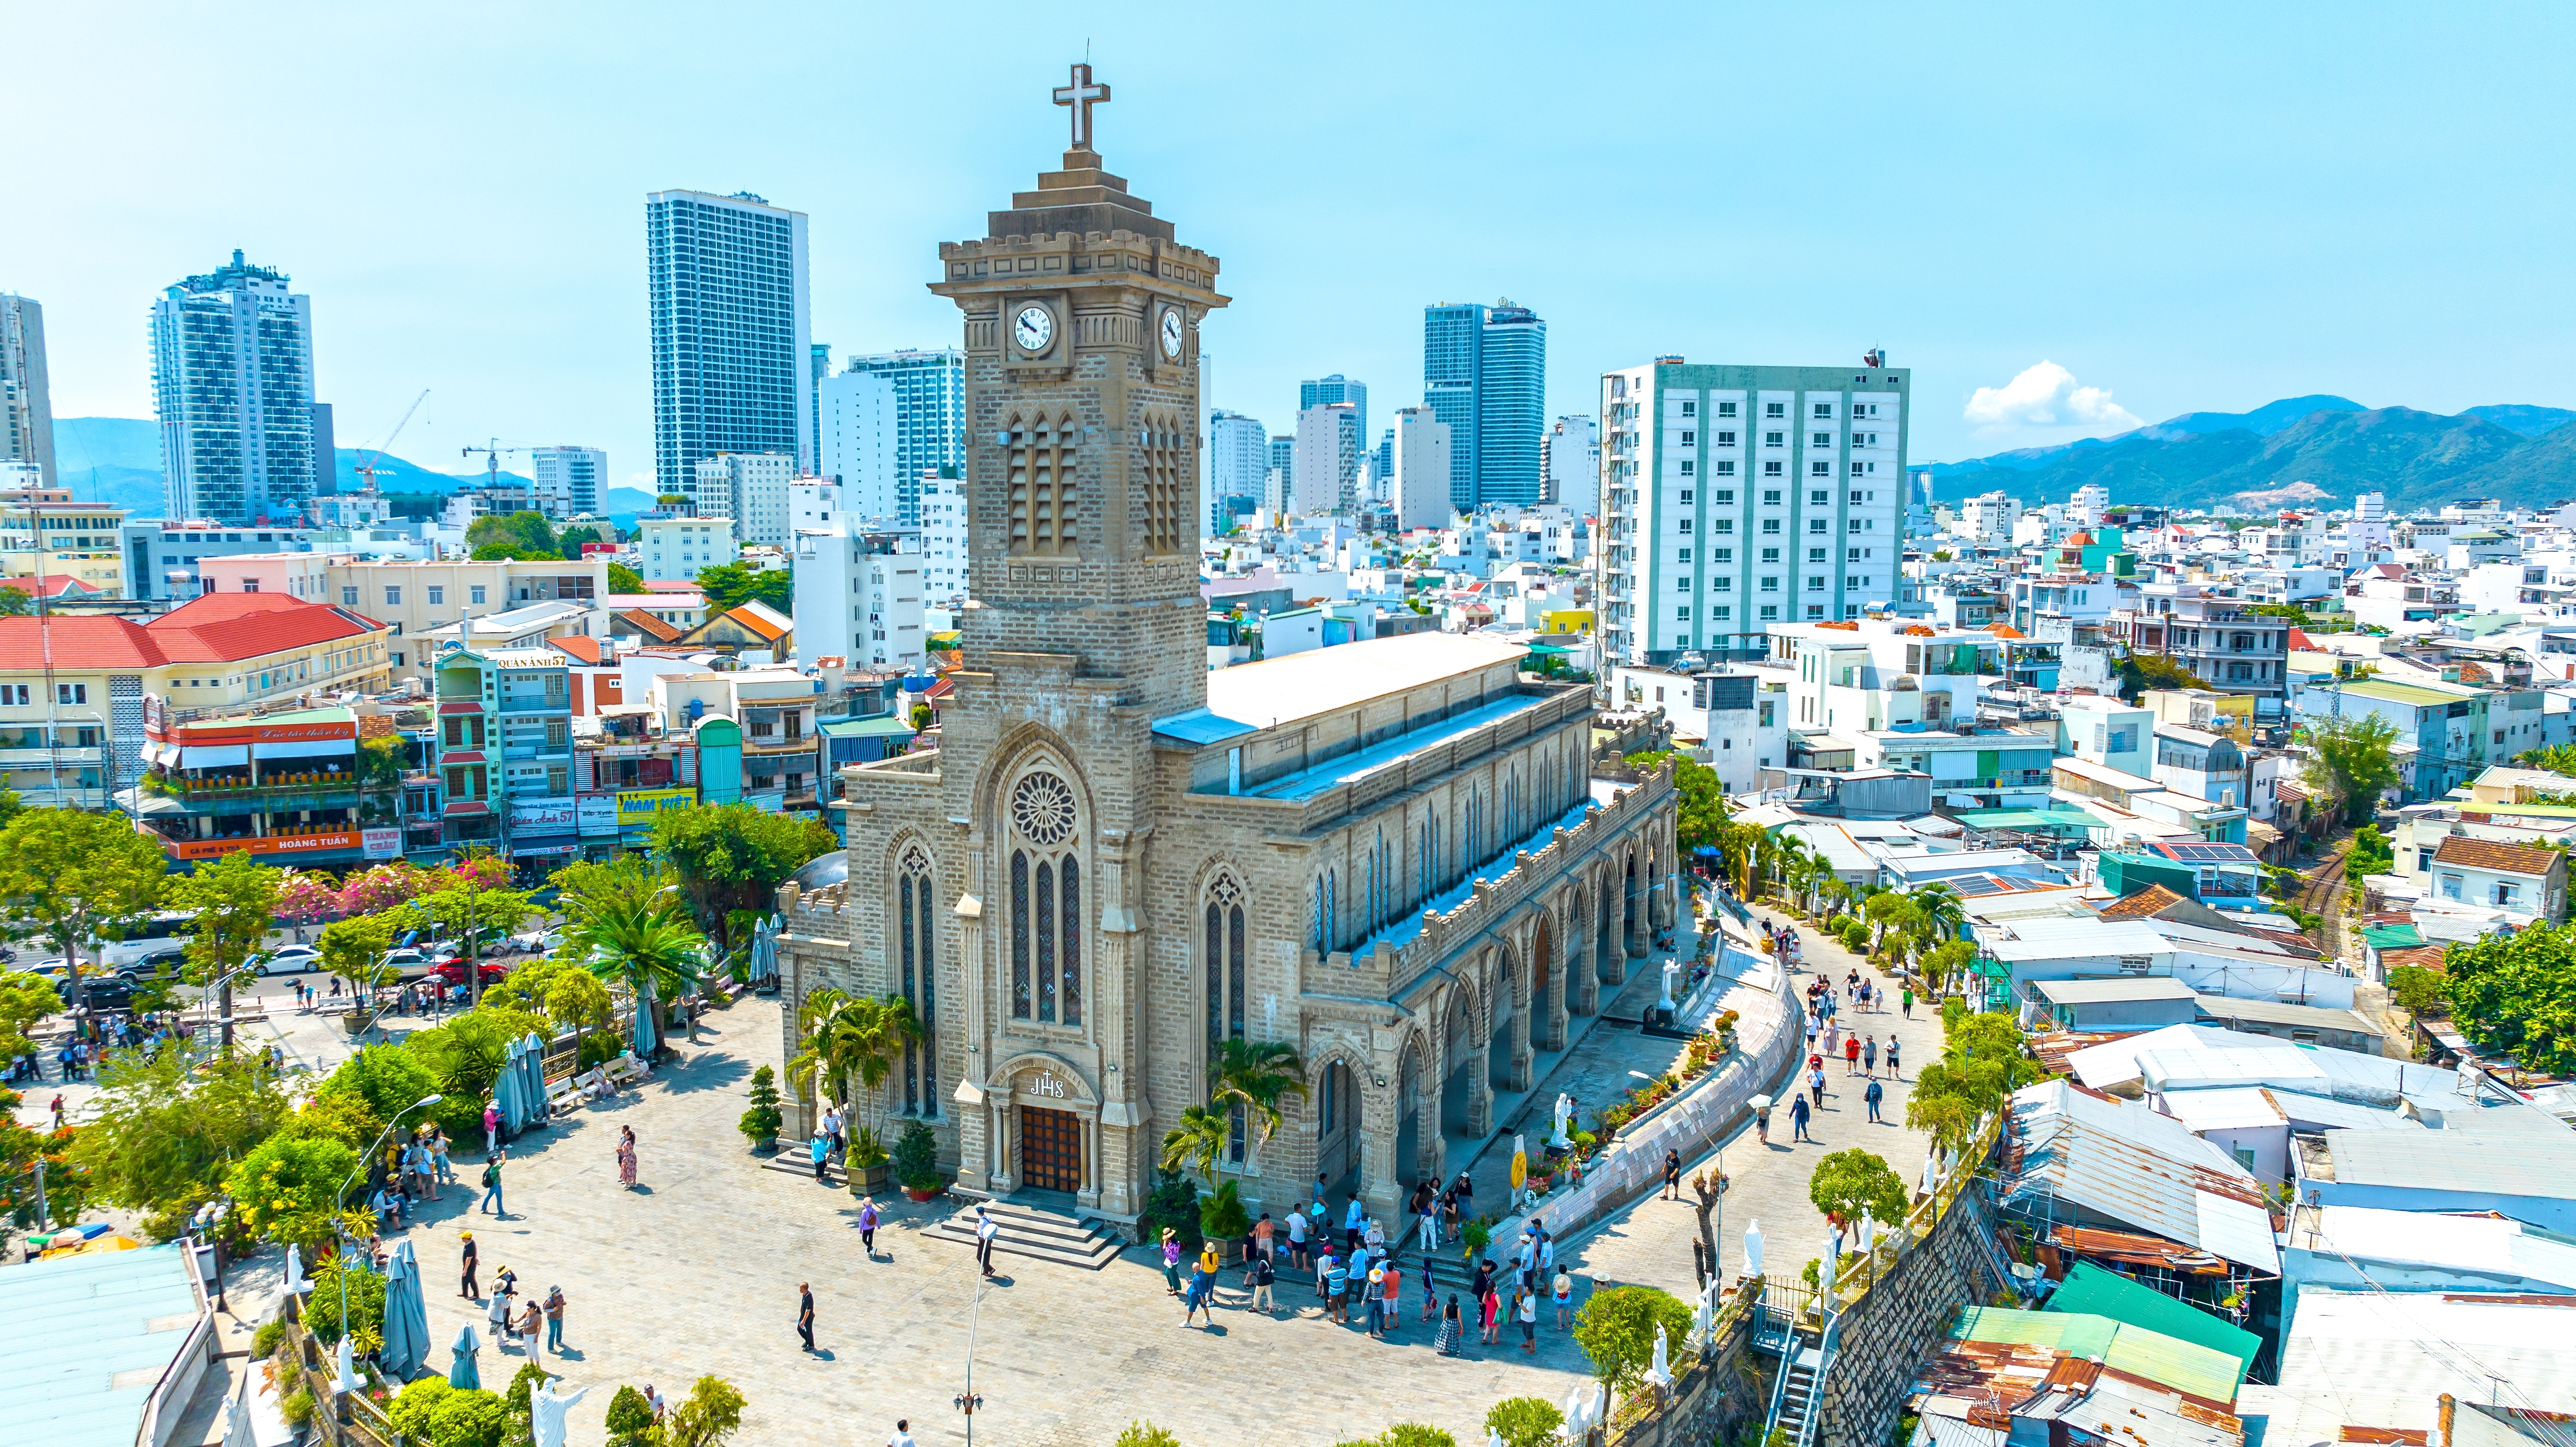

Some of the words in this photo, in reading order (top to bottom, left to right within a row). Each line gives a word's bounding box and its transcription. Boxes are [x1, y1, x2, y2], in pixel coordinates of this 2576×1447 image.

[498, 657, 527, 669] QUÁN
[553, 656, 566, 665] 57
[623, 798, 656, 812] NAM
[560, 811, 573, 822] 57
[279, 839, 317, 849] HOÀNG
[320, 835, 349, 846] TUẤN
[1031, 1070, 1064, 1098] JHS
